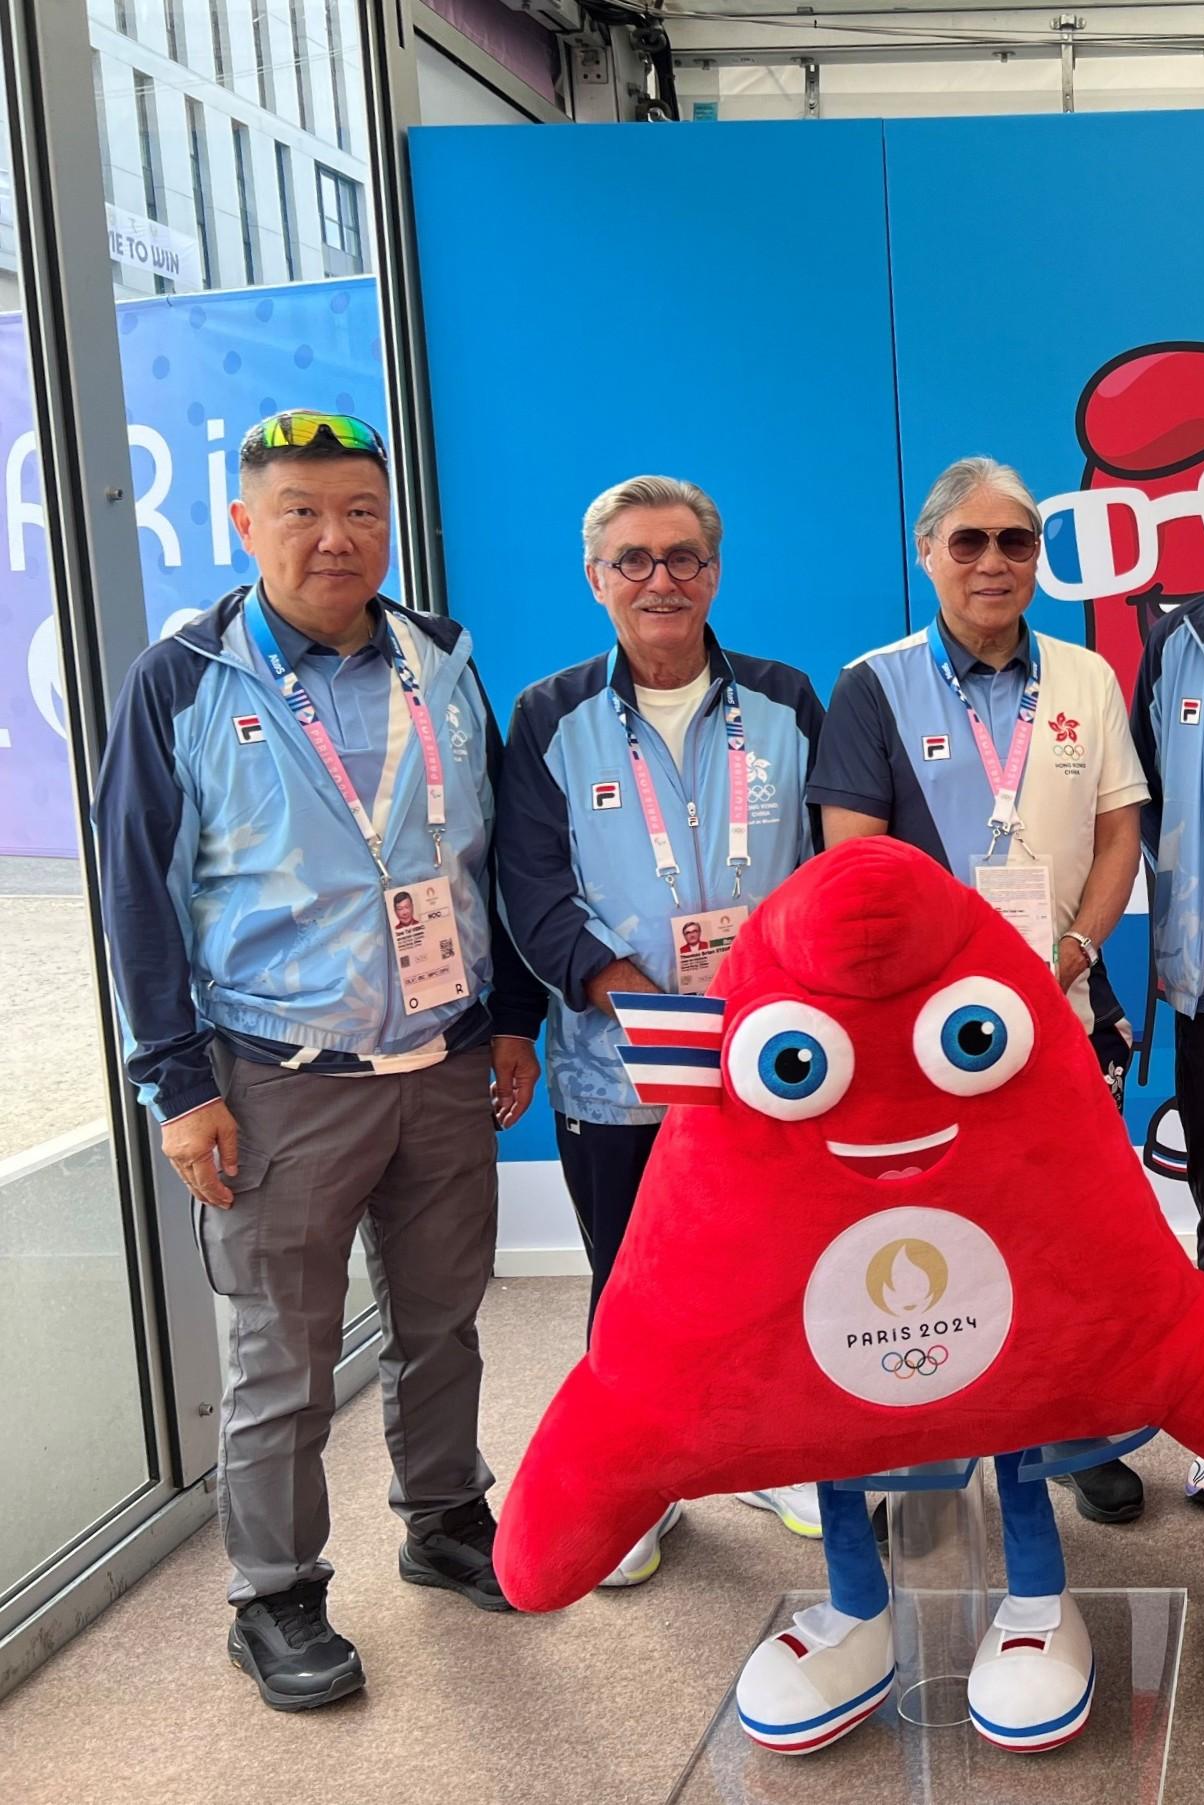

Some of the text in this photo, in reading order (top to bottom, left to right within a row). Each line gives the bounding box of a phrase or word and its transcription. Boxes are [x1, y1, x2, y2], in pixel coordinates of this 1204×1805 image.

[126, 237, 149, 263] TO
[151, 242, 180, 275] WIN
[456, 984, 463, 994] R
[847, 1316, 977, 1348] PARIS 2024
